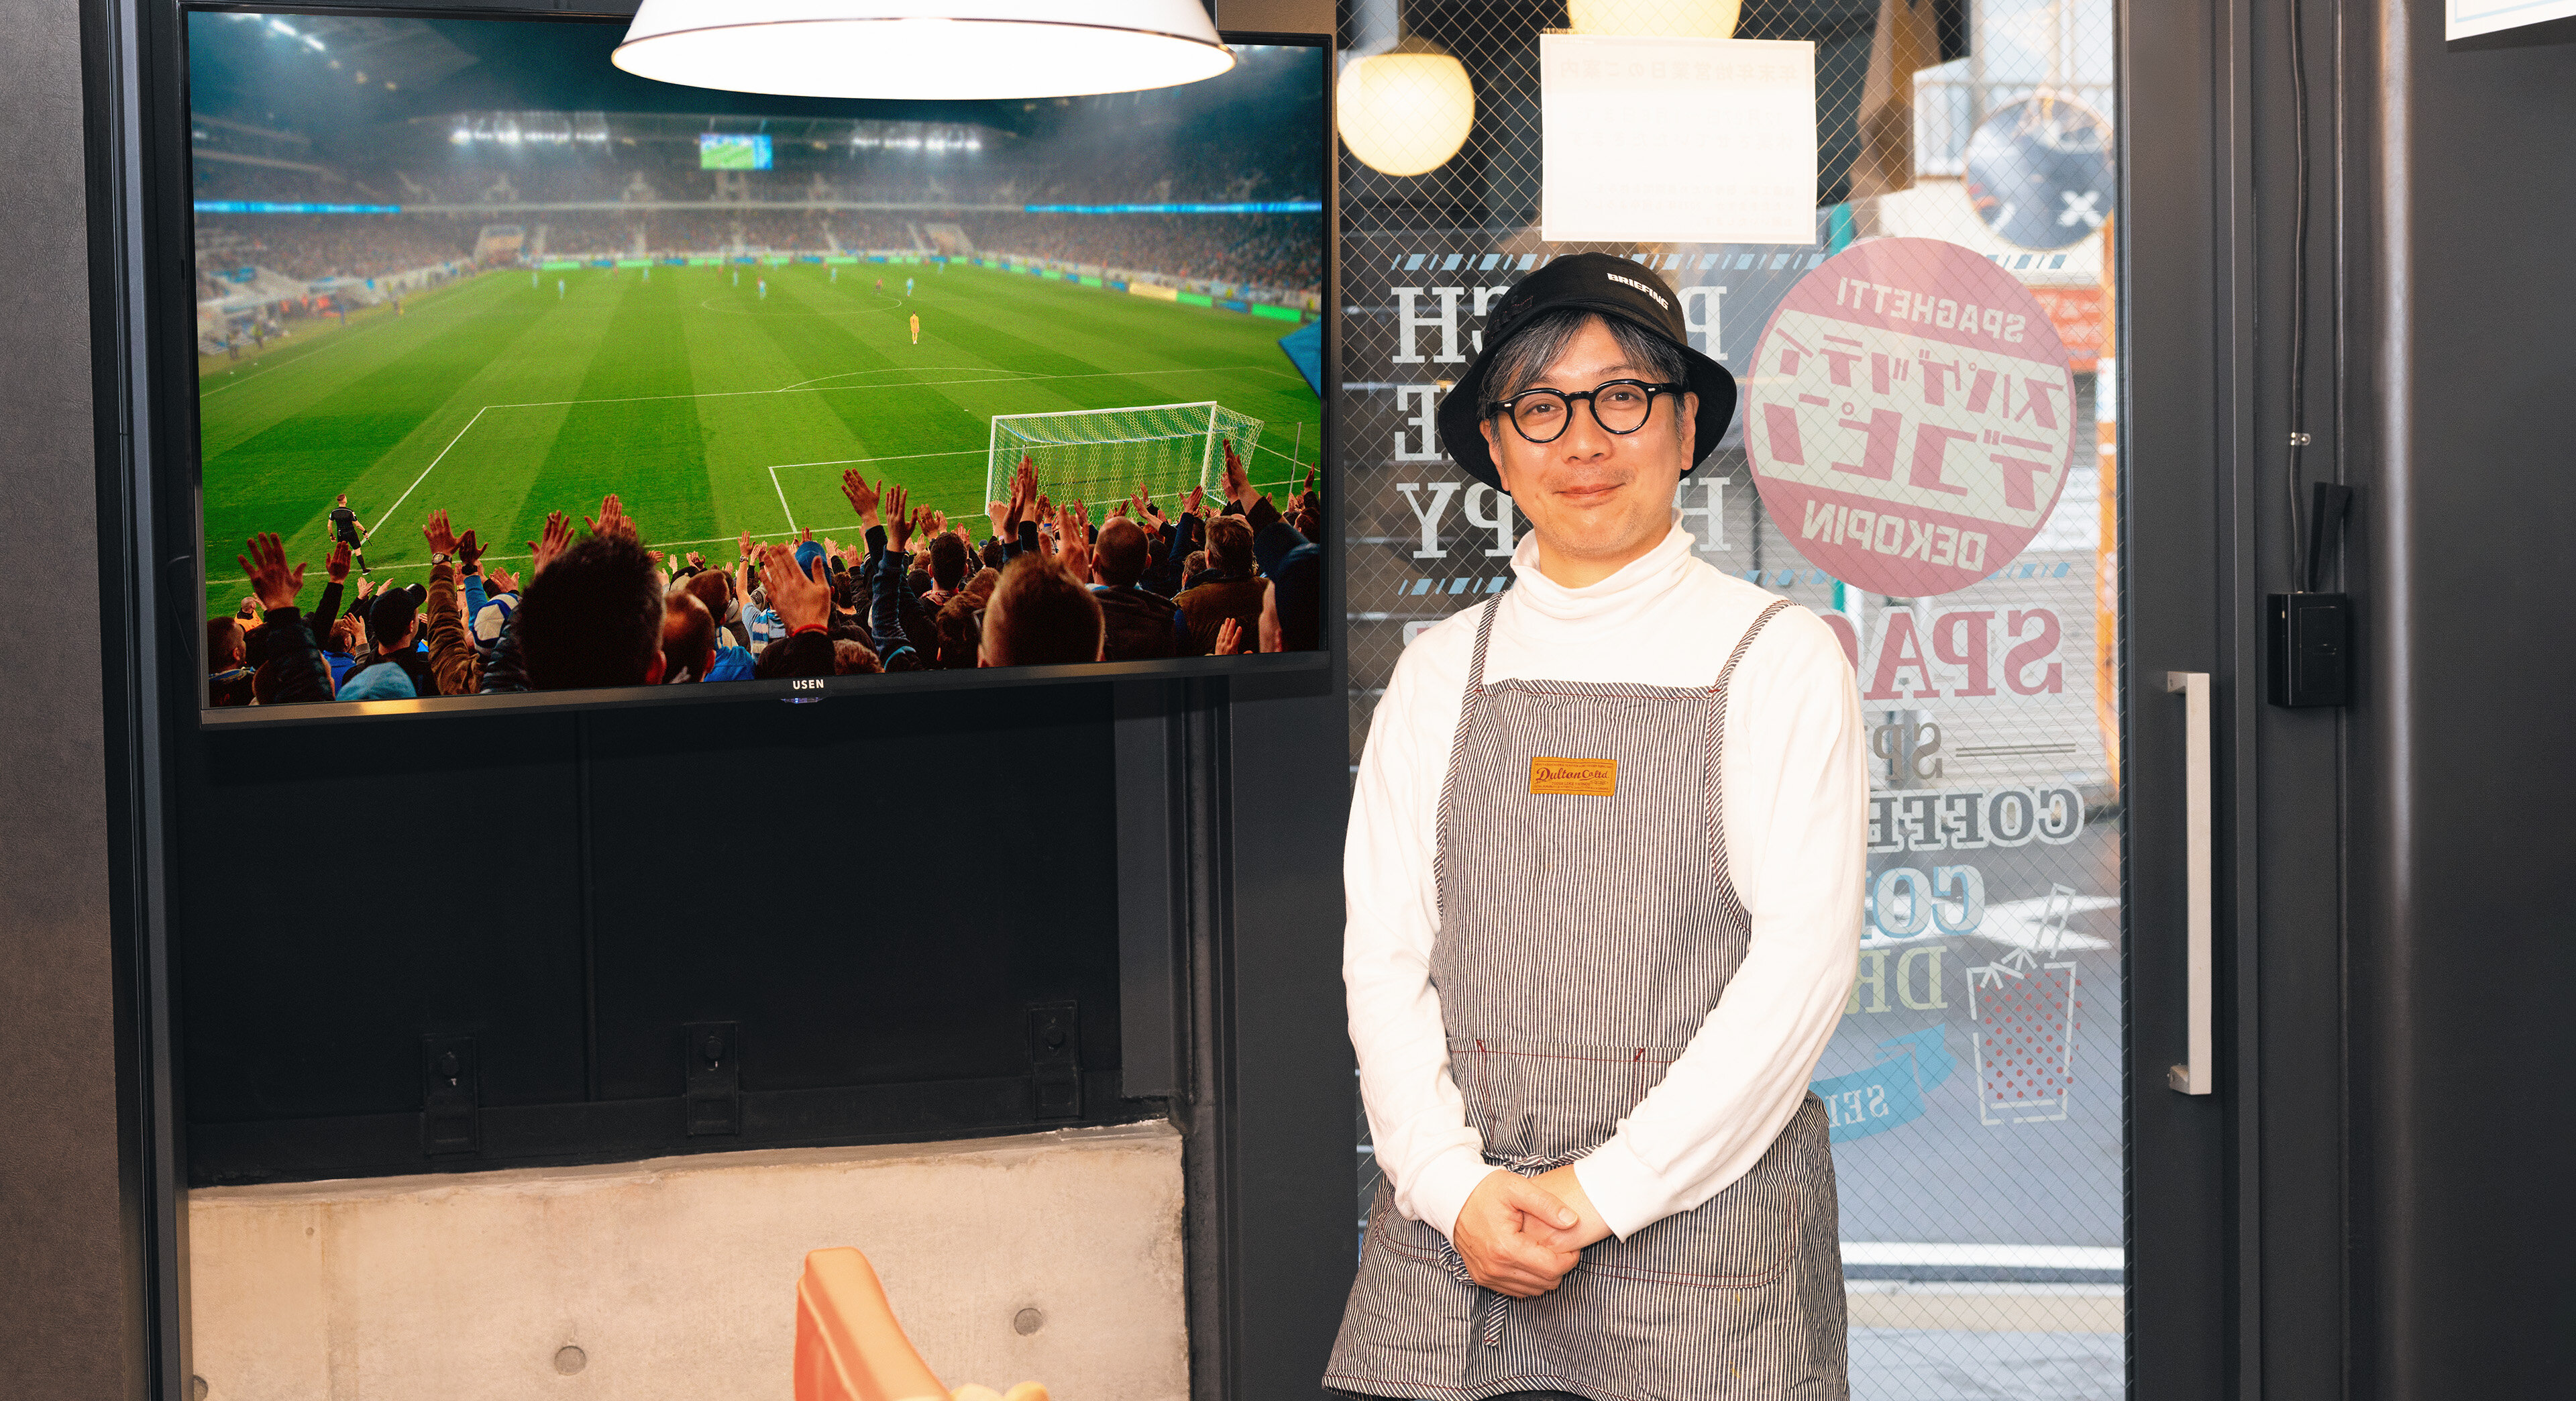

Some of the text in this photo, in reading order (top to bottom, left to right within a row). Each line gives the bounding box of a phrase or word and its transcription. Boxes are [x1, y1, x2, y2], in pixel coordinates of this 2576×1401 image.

[1607, 273, 1669, 311] BRIEFING
[792, 678, 824, 690] USEN
[1535, 767, 1581, 782] Dulton
